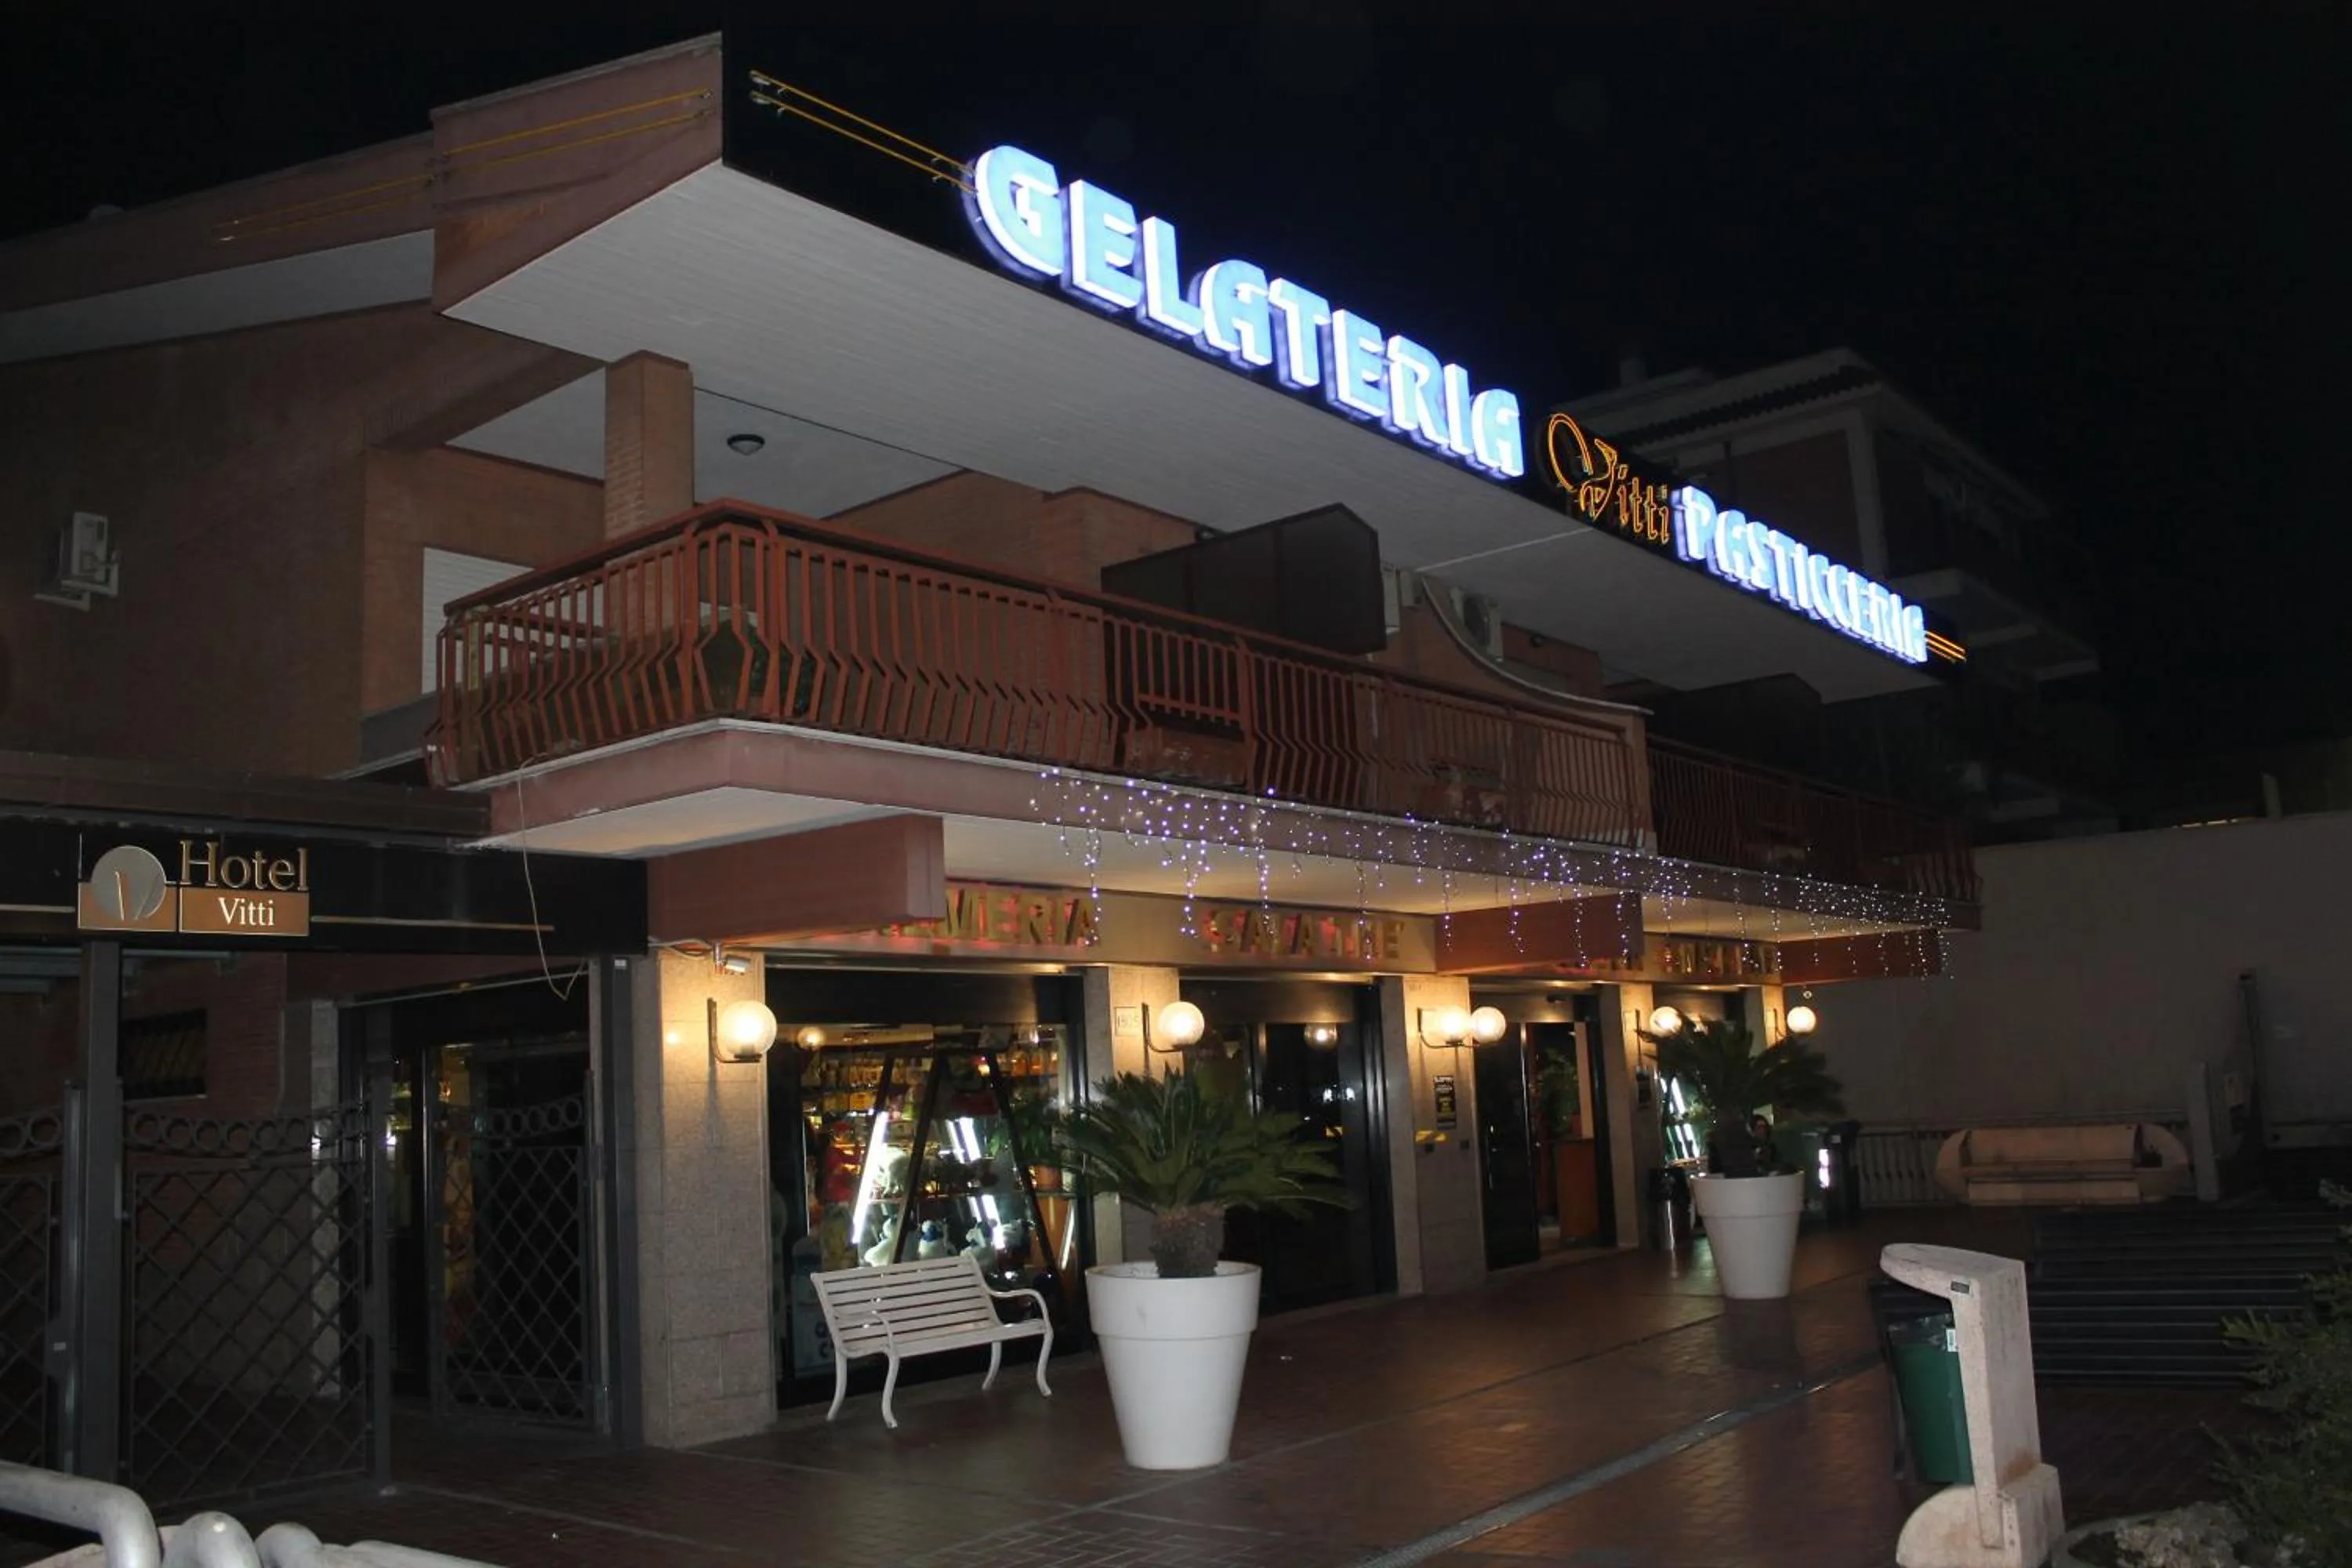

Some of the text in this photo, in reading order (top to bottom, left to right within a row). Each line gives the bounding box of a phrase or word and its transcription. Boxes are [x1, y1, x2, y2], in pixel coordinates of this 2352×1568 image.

[969, 144, 1927, 663] GELATERIA Vitti PASTICCERIA
[179, 839, 310, 892] Hotel
[217, 896, 275, 927] Vitti
